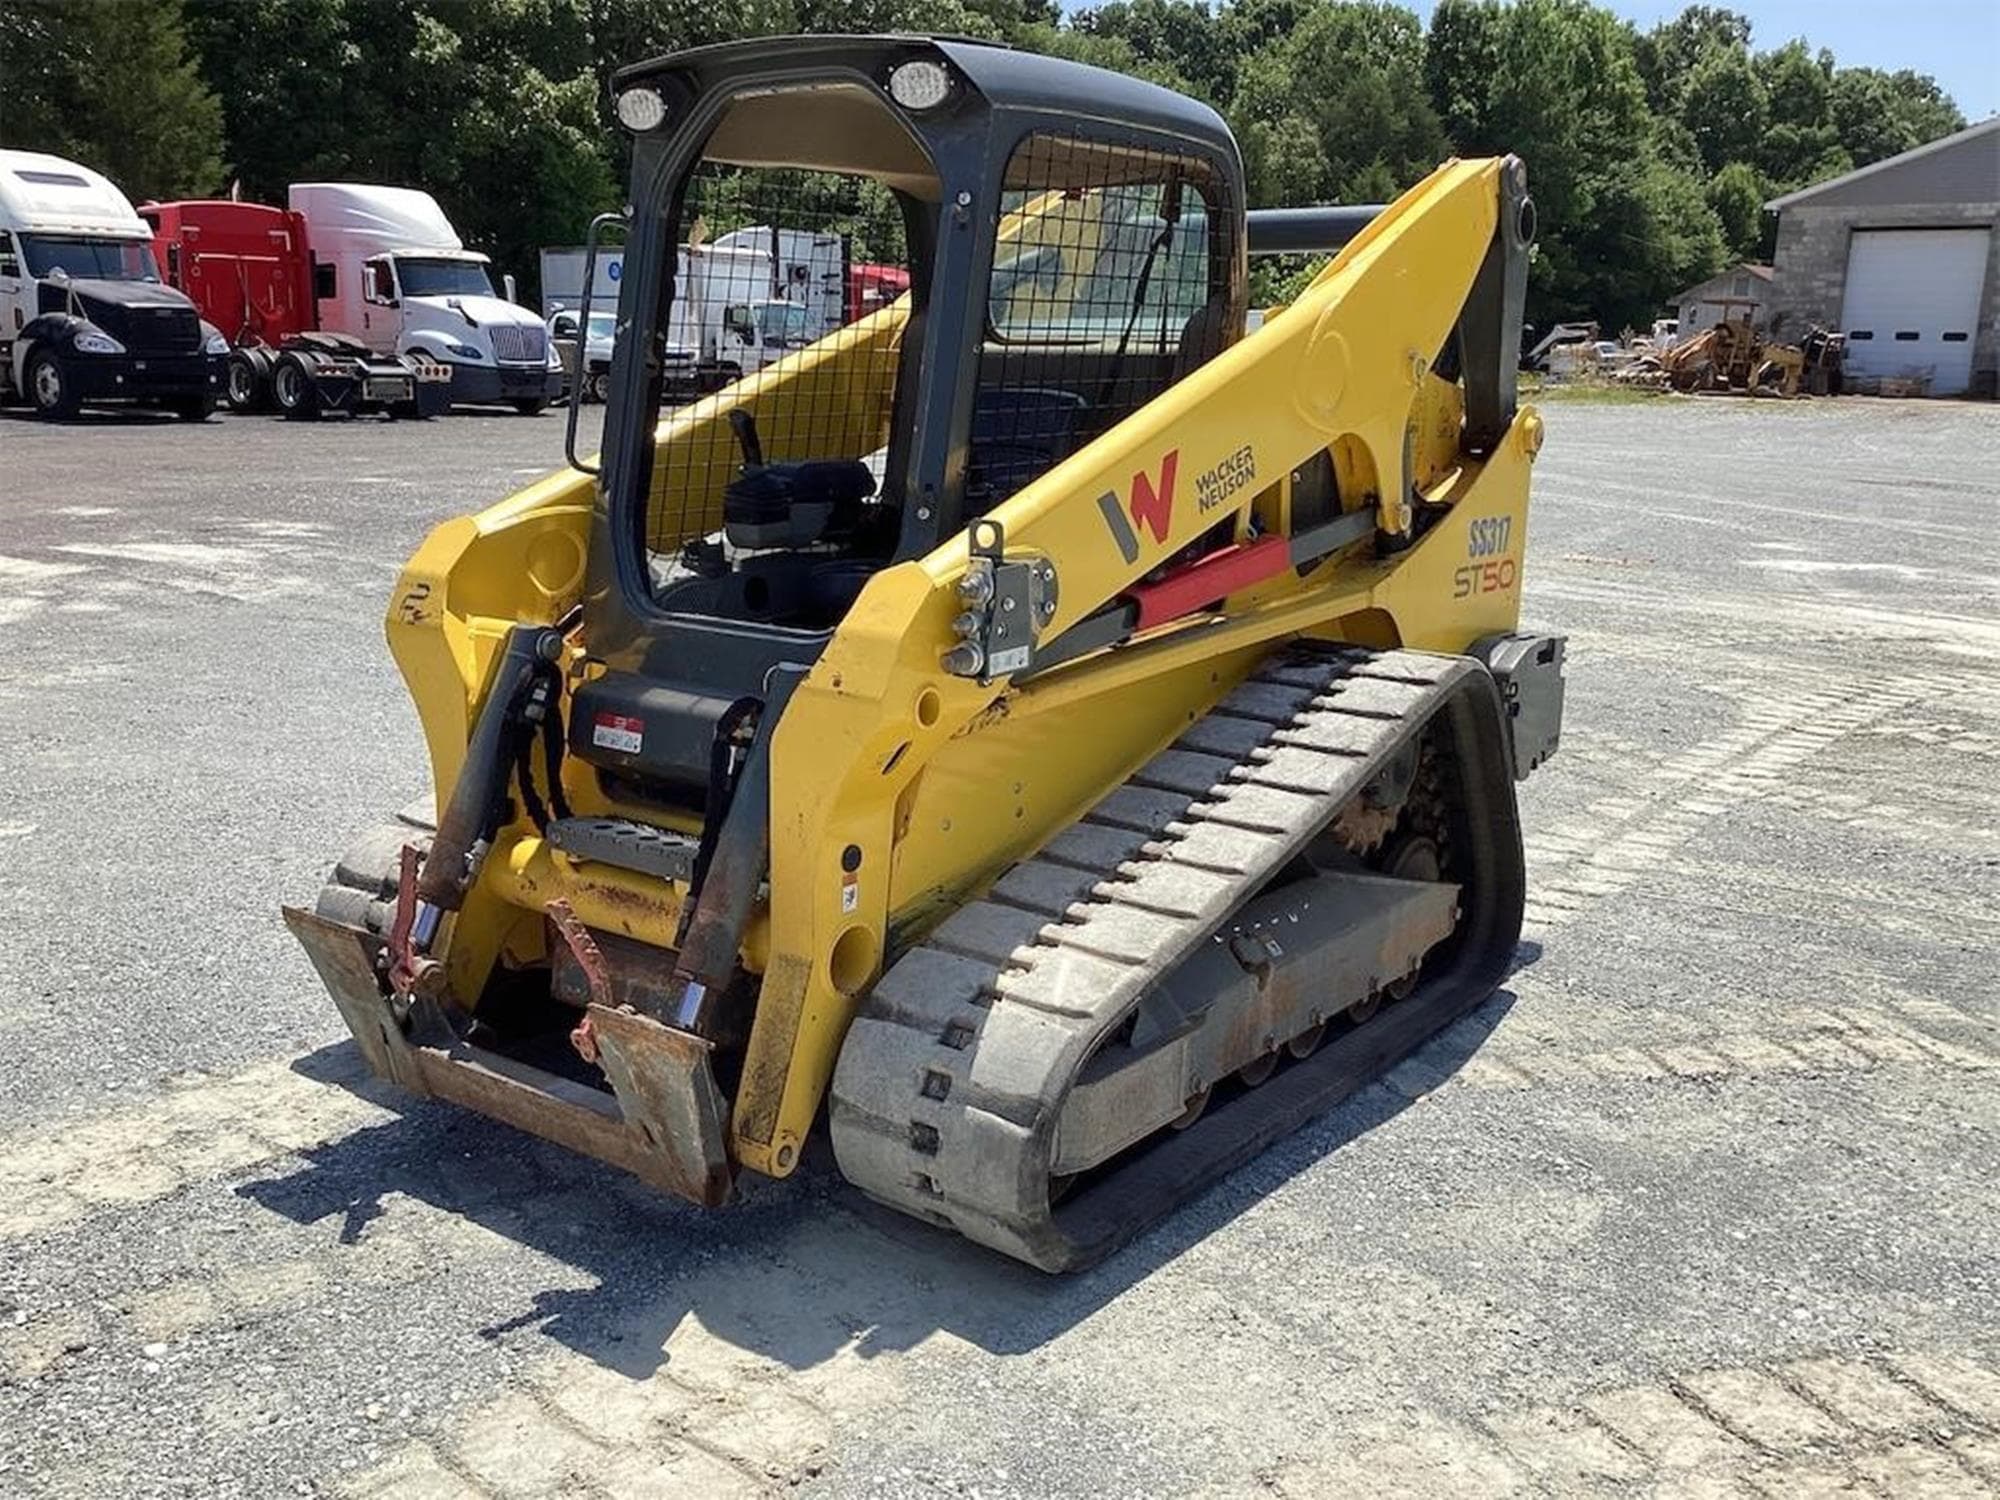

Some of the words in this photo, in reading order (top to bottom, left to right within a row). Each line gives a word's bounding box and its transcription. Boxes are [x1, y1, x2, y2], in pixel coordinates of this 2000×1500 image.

[1195, 445, 1253, 494] WACKER
[1199, 462, 1256, 515] NEUSON
[1468, 516, 1512, 557] SS317
[1453, 559, 1517, 599] ST50
